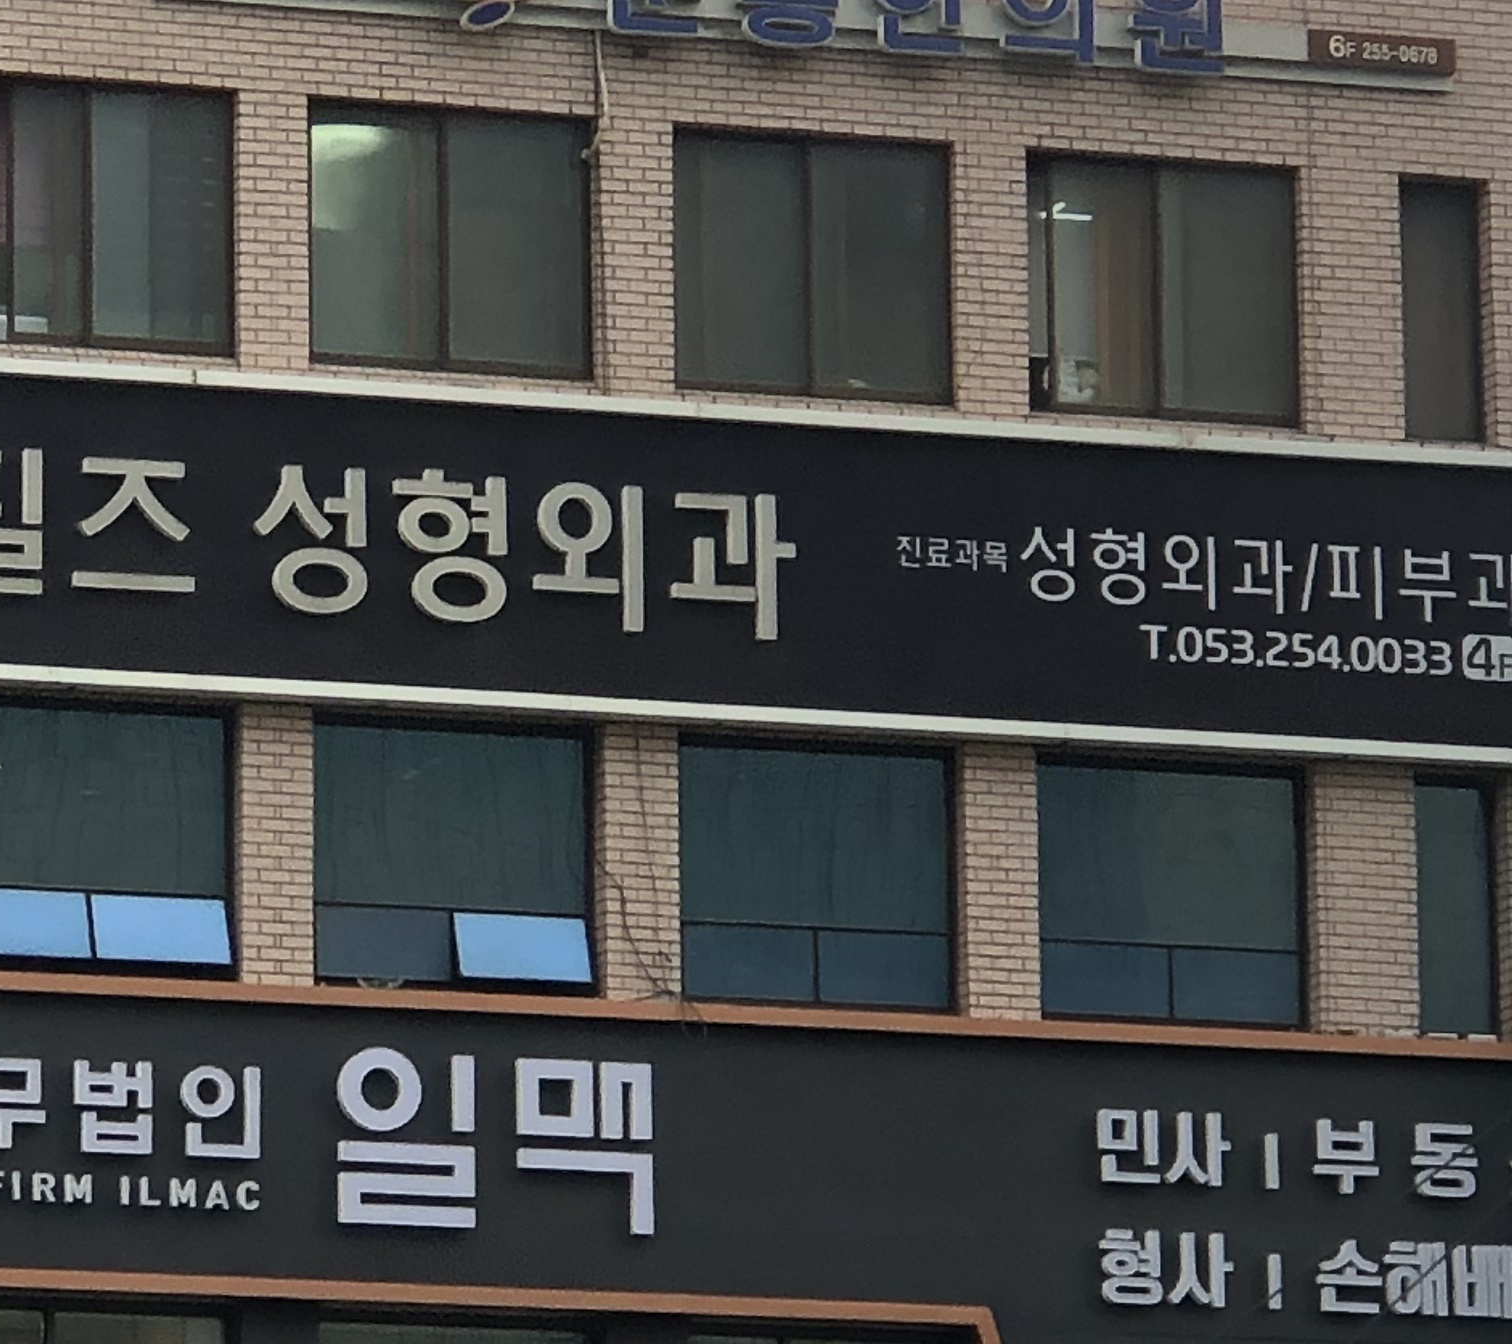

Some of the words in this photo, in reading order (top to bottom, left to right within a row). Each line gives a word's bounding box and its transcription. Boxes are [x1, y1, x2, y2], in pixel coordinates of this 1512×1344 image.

[1328, 35, 1357, 59] 6F
[1362, 41, 1438, 64] 255-0678
[252, 464, 797, 642] 성형외과
[895, 535, 1009, 573] 진료과목
[1138, 623, 1454, 676] T.053.254.0033
[336, 1045, 655, 1237] 일맥
[1096, 1108, 1232, 1188] 민사
[119, 1175, 263, 1212] ILMAC
[1098, 1228, 1235, 1311] 형사
